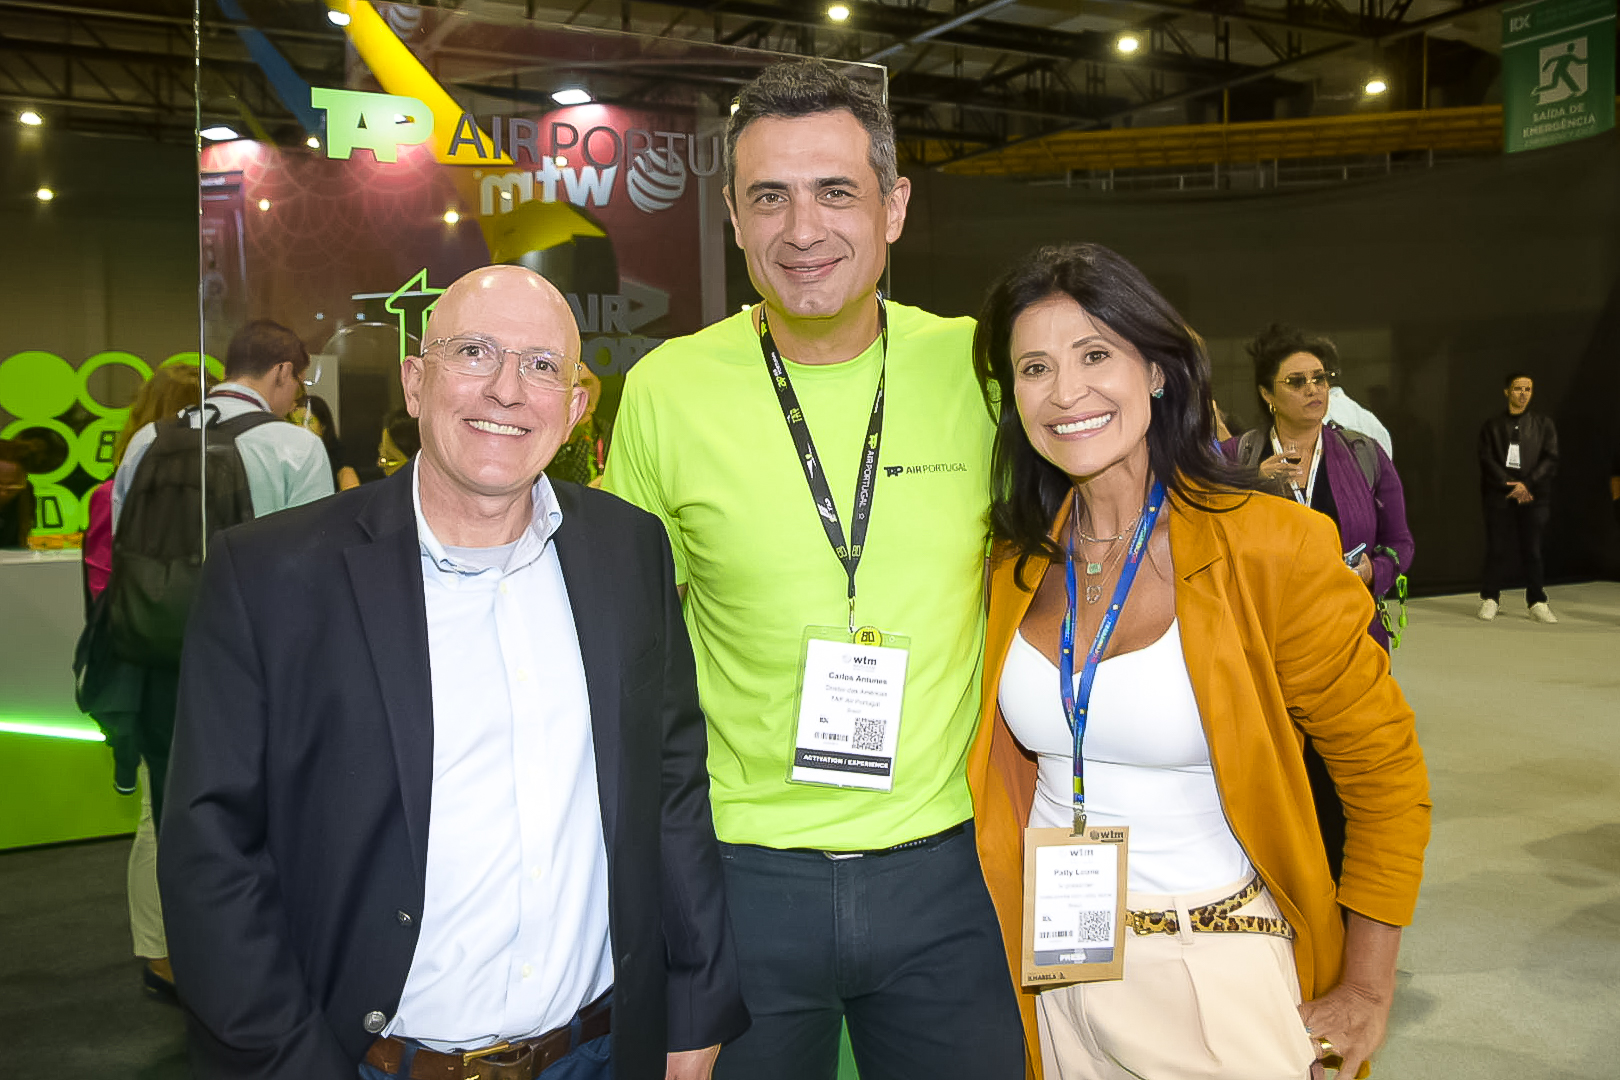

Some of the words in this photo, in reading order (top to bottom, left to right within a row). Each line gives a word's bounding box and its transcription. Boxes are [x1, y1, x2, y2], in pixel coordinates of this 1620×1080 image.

[1569, 103, 1585, 113] DE
[311, 87, 434, 163] TAP
[447, 112, 539, 162] AIR
[551, 122, 720, 177] PORTU
[866, 450, 874, 464] AIR
[884, 466, 903, 477] TAP
[906, 465, 921, 474] AIR
[922, 463, 967, 473] PORTUGAL
[859, 464, 873, 508] PORTUGAL
[853, 656, 877, 666] wtm
[829, 672, 853, 681] Carlos
[803, 754, 843, 766] ACTIVATION
[848, 758, 889, 769] EXPERIENCE
[1100, 830, 1124, 839] wtm
